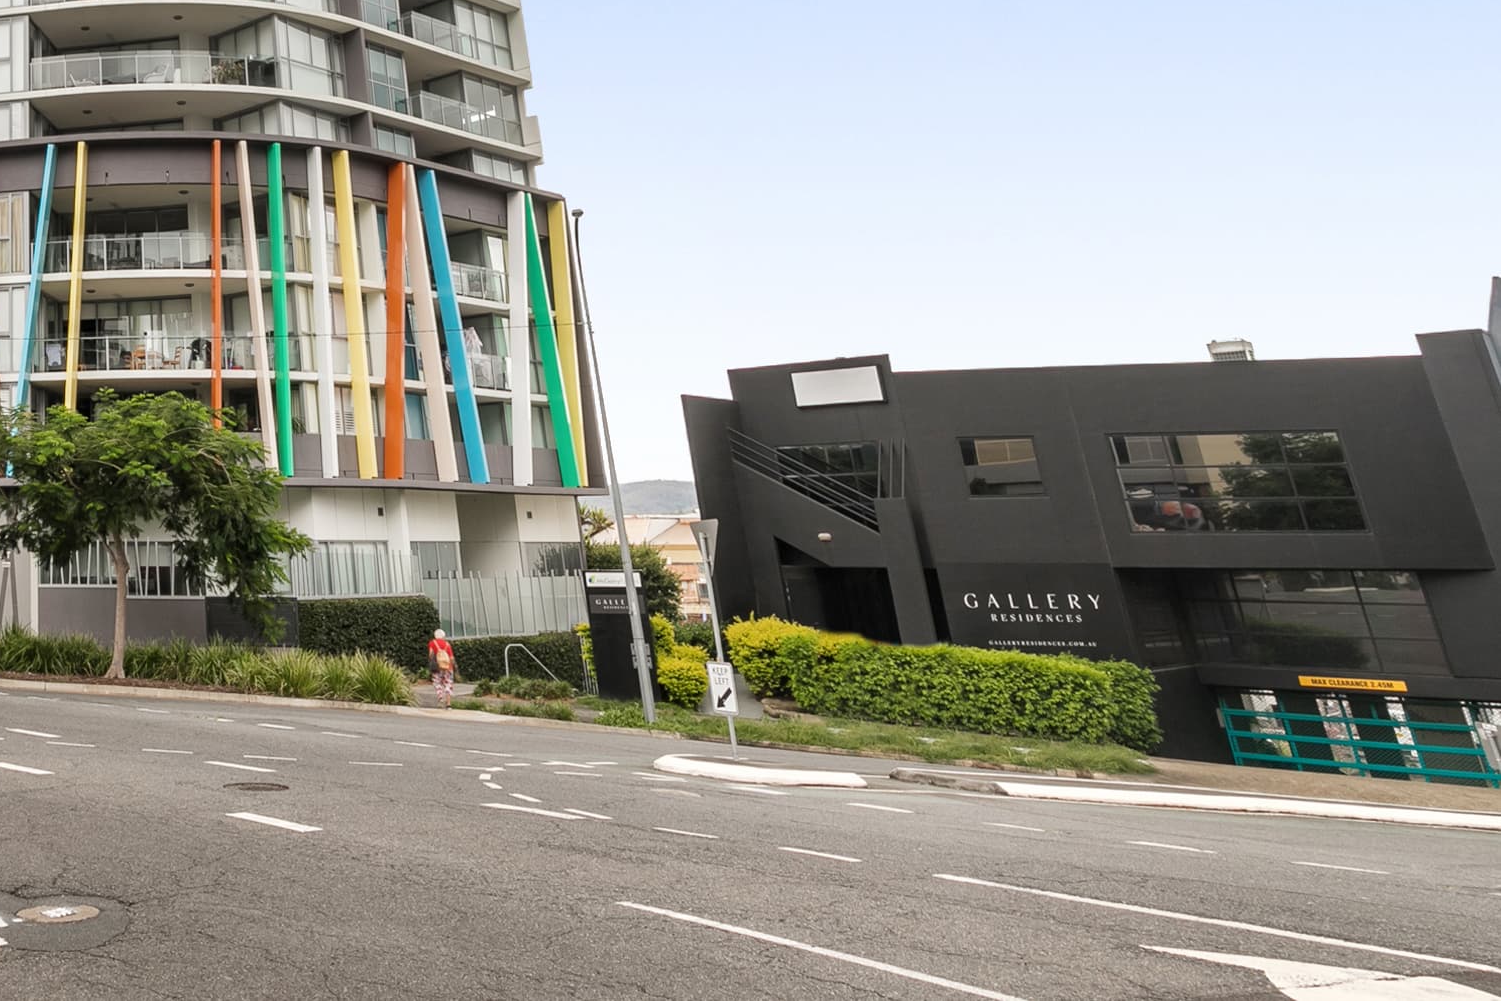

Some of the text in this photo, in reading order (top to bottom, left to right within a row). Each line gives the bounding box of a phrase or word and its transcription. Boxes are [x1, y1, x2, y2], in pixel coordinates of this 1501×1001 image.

[963, 592, 1100, 610] GALLERY
[990, 613, 1083, 623] RESIDENCES
[1328, 679, 1368, 688] CLEARANCE
